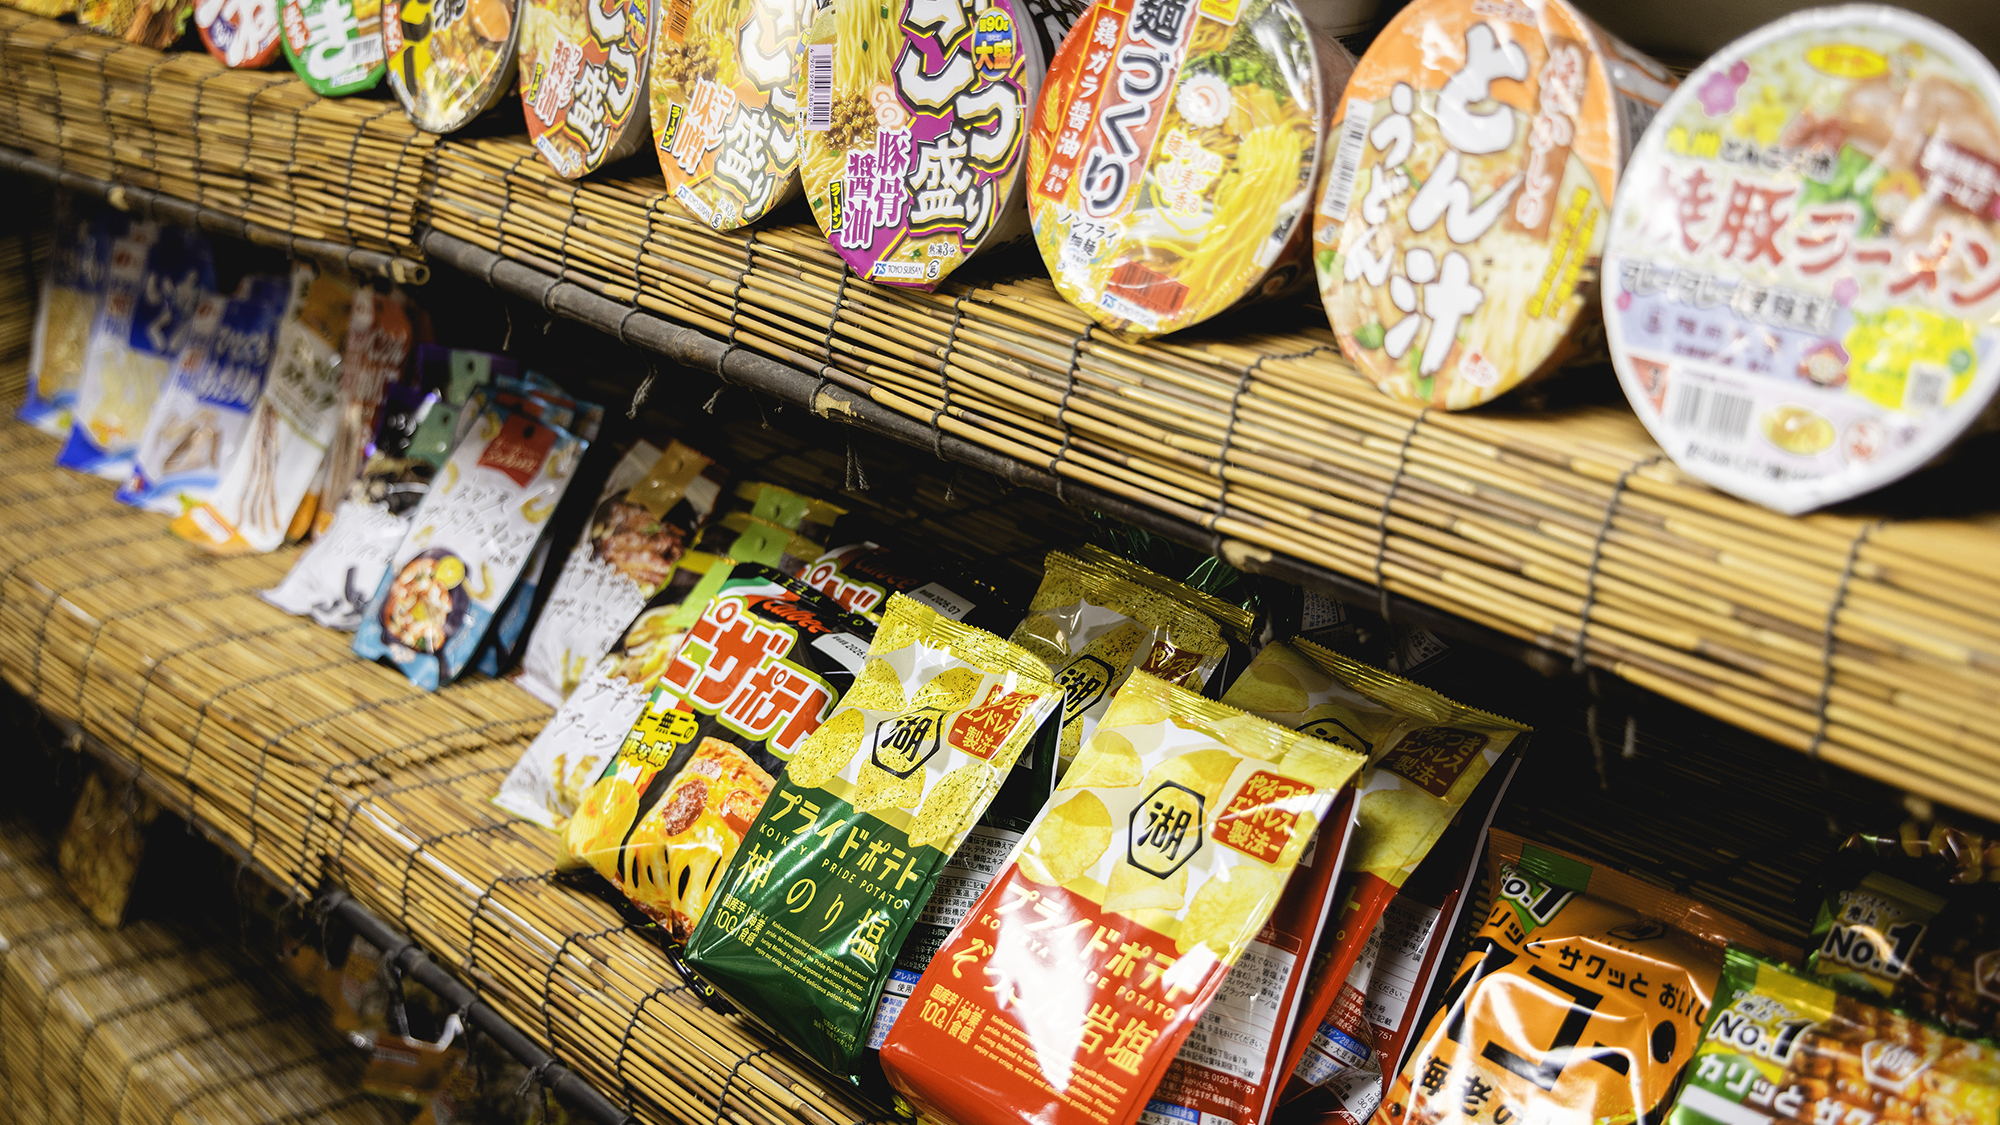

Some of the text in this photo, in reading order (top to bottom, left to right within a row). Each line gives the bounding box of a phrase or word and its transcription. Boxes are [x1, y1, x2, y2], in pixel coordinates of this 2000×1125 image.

[975, 41, 1013, 71] 大盛
[1057, 17, 1118, 160] 鶏ガラ醤油
[1084, 0, 1187, 210] 麺づくり
[847, 153, 875, 246] 醤油
[875, 129, 908, 227] 豚骨
[1345, 82, 1414, 287] うどん
[1384, 21, 1529, 378] とん汁
[830, 181, 844, 230] ラーメン
[1057, 212, 1118, 247] ノンフライ
[888, 265, 904, 275] TOYO
[904, 265, 924, 275] SUISAN
[762, 600, 832, 634] Calbee
[930, 593, 962, 616] 2026.07
[662, 600, 830, 751] ピザポテト
[881, 715, 933, 763] 湖
[1396, 740, 1465, 774] エンドレス
[1416, 726, 1482, 757] やみつき
[1247, 774, 1310, 805] やみつき
[1391, 753, 1438, 787] 製法
[769, 789, 919, 892] プライドポテト
[1136, 800, 1193, 861] 湖
[1227, 795, 1294, 836] エンドレス
[1227, 818, 1272, 856] 製法
[759, 822, 904, 910] KOIKEYA PRIDE POTATO
[721, 892, 747, 915] 国産芋
[739, 842, 890, 965] 神のり塩
[737, 927, 759, 947] 食感
[765, 929, 777, 939] pride.
[813, 958, 826, 970] Pride
[825, 965, 843, 979] Potato
[842, 975, 865, 991] Manufac-
[772, 921, 787, 934] Koikeya
[809, 945, 823, 956] potato
[822, 952, 834, 963] chips
[851, 969, 869, 982] utmost
[993, 880, 1198, 1002] プライドポテト
[1824, 922, 1928, 977] No.1
[771, 944, 787, 957] Method
[802, 964, 823, 980] Japanese
[823, 977, 845, 993] delicacy.
[845, 988, 862, 1002] Please
[783, 964, 798, 977] savory
[806, 978, 827, 994] delicious
[826, 990, 843, 1004] potato
[929, 983, 960, 1007] 国産芋
[1558, 944, 1650, 999] サクッと
[919, 999, 948, 1030] 100%
[956, 1004, 983, 1029] 神業
[1115, 985, 1177, 1022] POTATO
[947, 1019, 975, 1045] 食感
[984, 1024, 1002, 1038] pride.
[1010, 1038, 1026, 1051] have
[1073, 1074, 1093, 1089] Potato
[991, 1014, 1013, 1031] Koikeya
[1095, 1073, 1107, 1083] the
[1105, 1079, 1128, 1094] utmost
[1709, 1011, 1817, 1064] No.1
[973, 1043, 990, 1057] enjoy
[988, 1052, 1000, 1062] our
[1014, 1067, 1035, 1083] savory
[1033, 1078, 1047, 1088] and
[1044, 1084, 1072, 1104] delicious
[1069, 1099, 1092, 1115] potato
[995, 1042, 1018, 1059] Method
[1093, 1098, 1116, 1115] Please
[1696, 1053, 1805, 1118] カリッと
